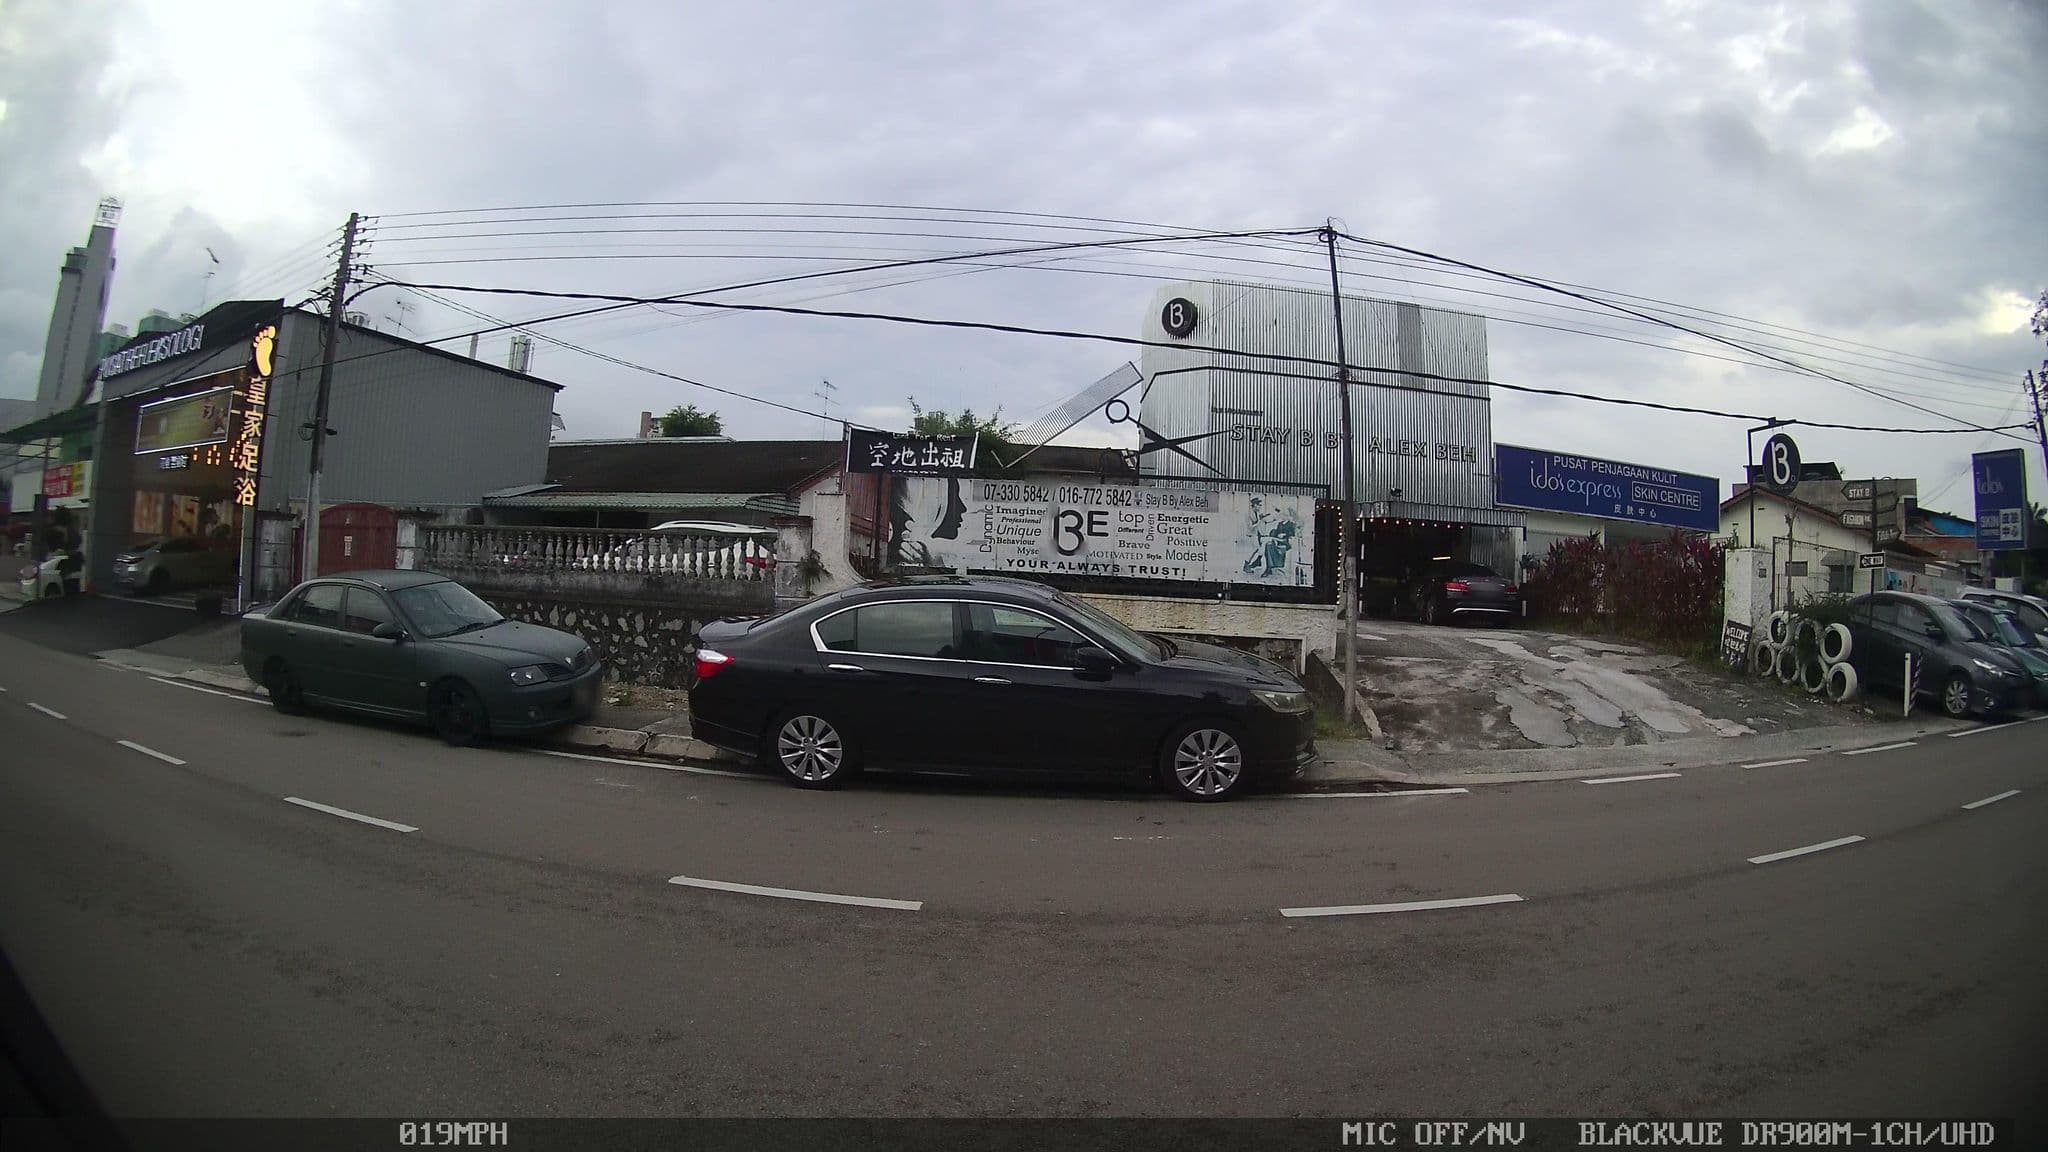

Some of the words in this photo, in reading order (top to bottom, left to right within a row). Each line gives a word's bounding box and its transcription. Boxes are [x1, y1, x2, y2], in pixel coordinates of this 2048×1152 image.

[1231, 424, 1290, 445] STAY
[1300, 430, 1313, 447] B
[1368, 436, 1427, 457] ALEX
[1435, 442, 1477, 463] BEH
[1553, 456, 1589, 471] PUSAT
[1591, 461, 1650, 480] PENJAGAAN
[1651, 470, 1678, 485] KULIT
[984, 484, 1020, 501] 07-330
[1023, 485, 1049, 502] 5842
[1059, 486, 1102, 505] 016-772
[1106, 489, 1132, 507] 5842
[1145, 493, 1161, 507] Stay
[1162, 494, 1168, 506] B
[1634, 487, 1658, 500] SKIN
[1660, 490, 1699, 507] CENTRE
[1119, 510, 1144, 527] top
[1157, 513, 1209, 525] Energetic
[996, 524, 1042, 538] Unique
[1156, 523, 1193, 536] Great
[996, 537, 1036, 546] Behaviour
[1118, 540, 1150, 549] Brave
[1167, 536, 1208, 547] Positive
[1165, 549, 1207, 562] Modest
[1006, 558, 1049, 569] YOUR
[1056, 560, 1120, 574] ALWAYS
[1128, 565, 1186, 577] TRUST!
